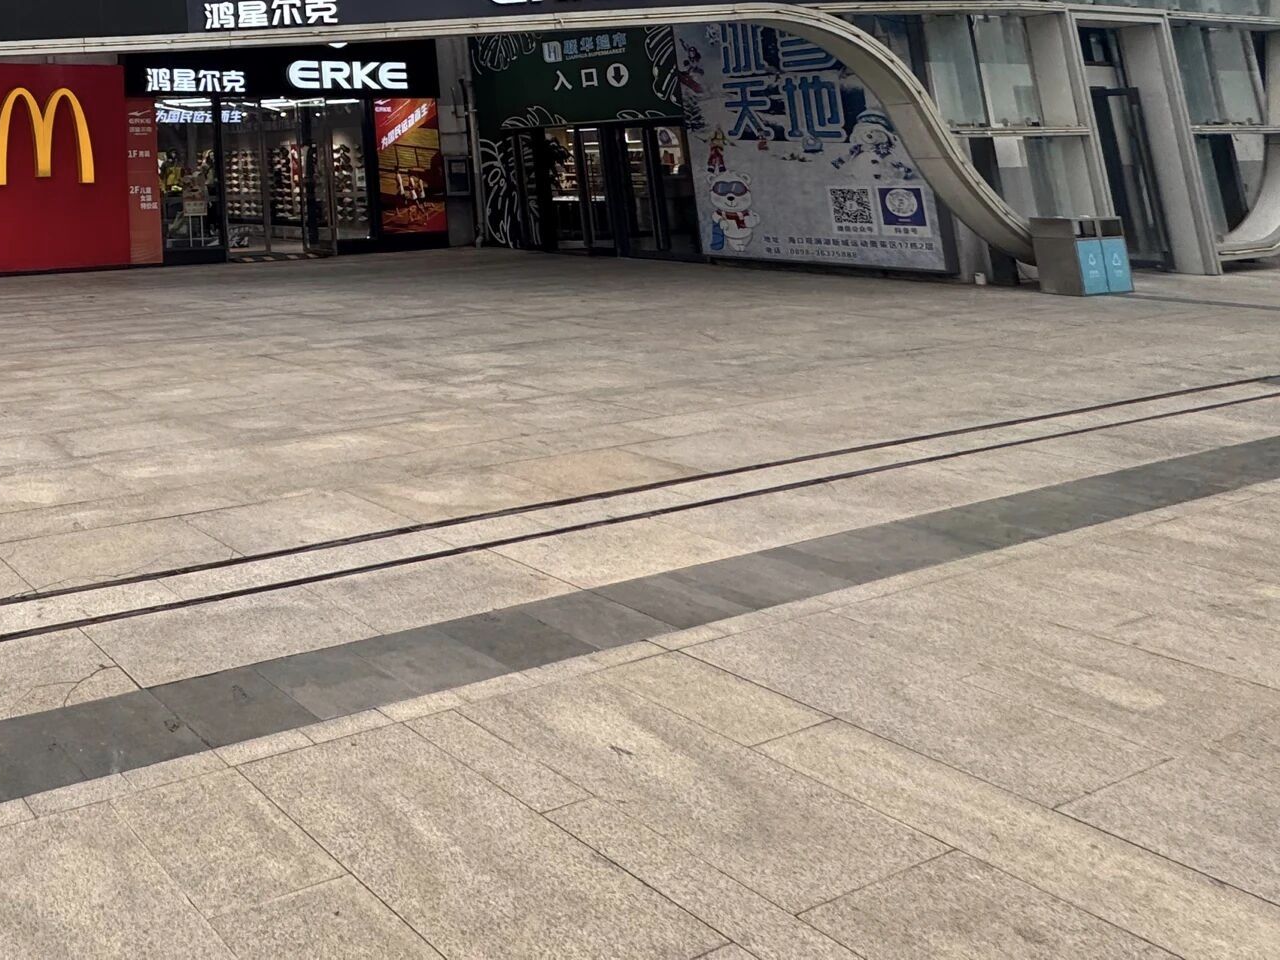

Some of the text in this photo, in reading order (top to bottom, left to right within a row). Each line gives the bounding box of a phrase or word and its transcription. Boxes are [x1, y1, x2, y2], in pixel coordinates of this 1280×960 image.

[146, 68, 245, 92] 鸿星尔克
[288, 60, 409, 90] ERKE
[553, 68, 598, 91] 入口
[721, 74, 844, 140] 天地
